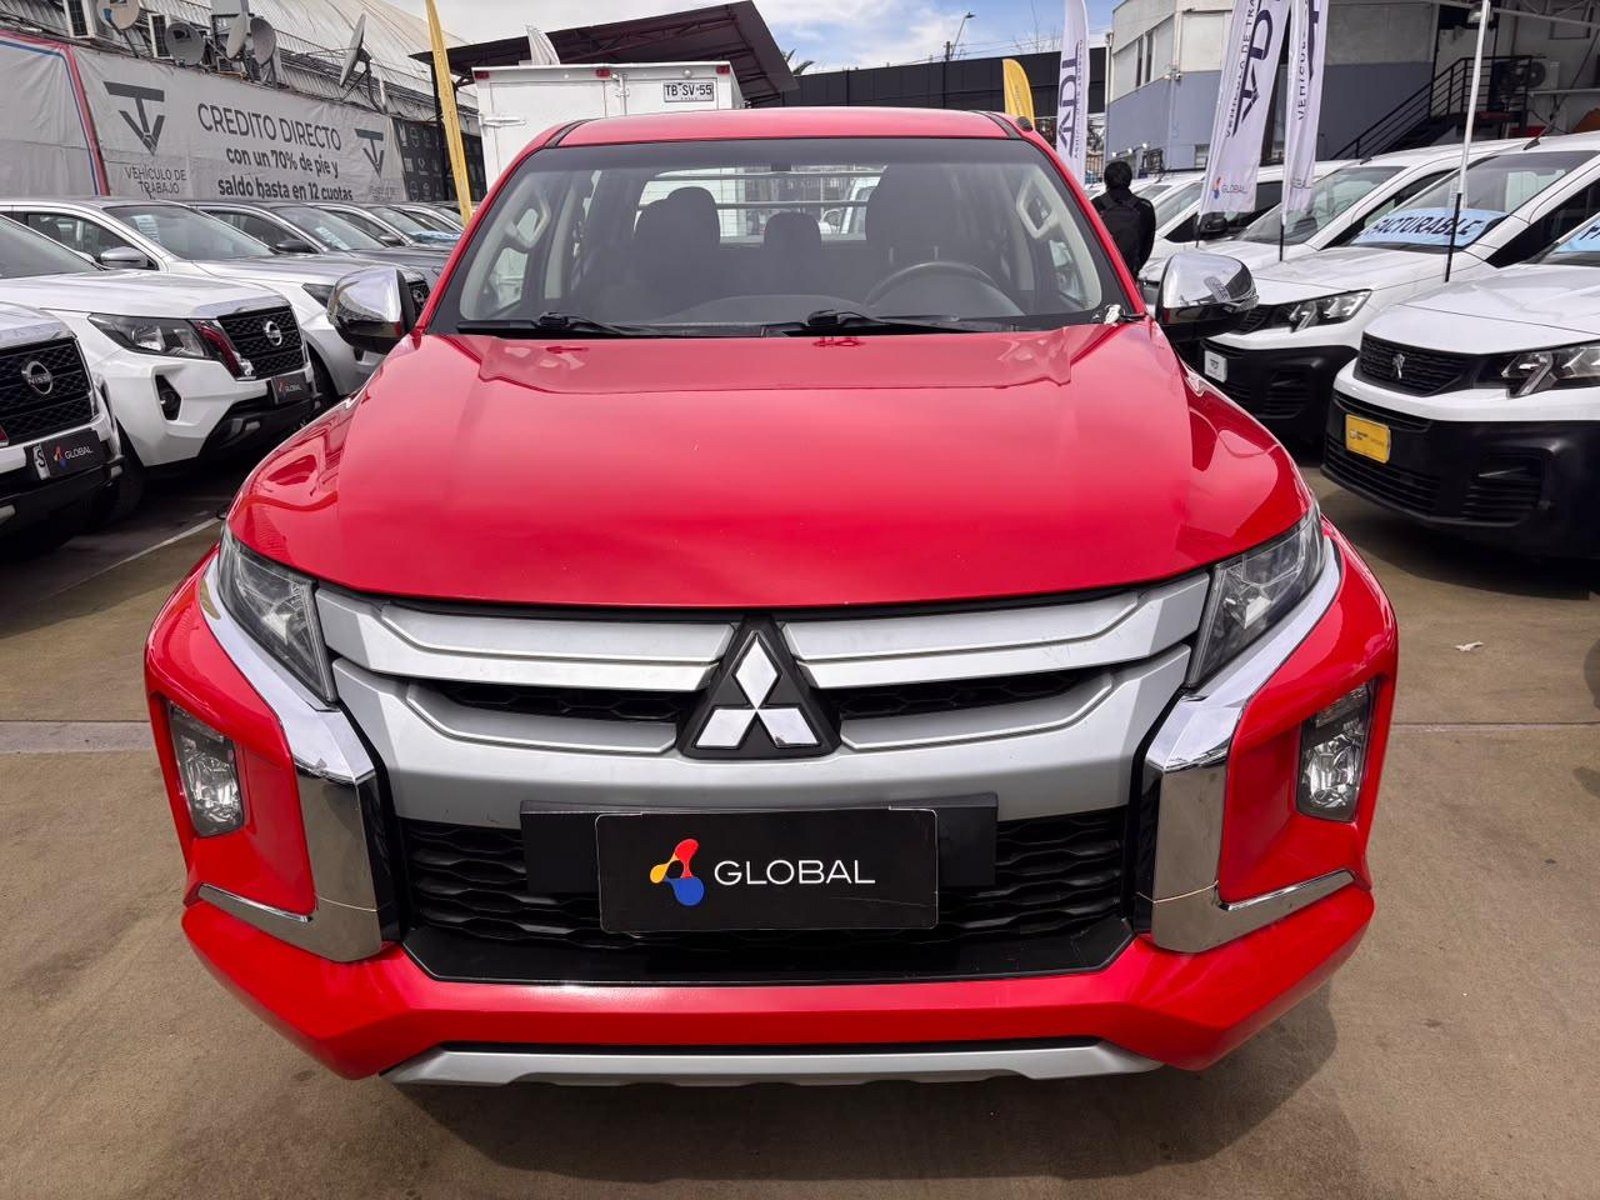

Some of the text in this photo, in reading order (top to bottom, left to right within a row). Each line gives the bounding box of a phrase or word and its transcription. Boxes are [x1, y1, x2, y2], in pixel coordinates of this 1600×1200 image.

[197, 103, 342, 151] CREDITO DIRECTO
[174, 169, 187, 181] DE
[226, 148, 339, 179] con un 70% de pie y
[138, 181, 180, 194] TRABAJO
[218, 174, 254, 197] saldo
[255, 177, 290, 199] hasta
[292, 184, 307, 200] en
[308, 182, 319, 200] 12
[320, 187, 353, 201] cuotas
[64, 446, 94, 460] GLOBAL
[714, 859, 876, 886] GLOBAL
